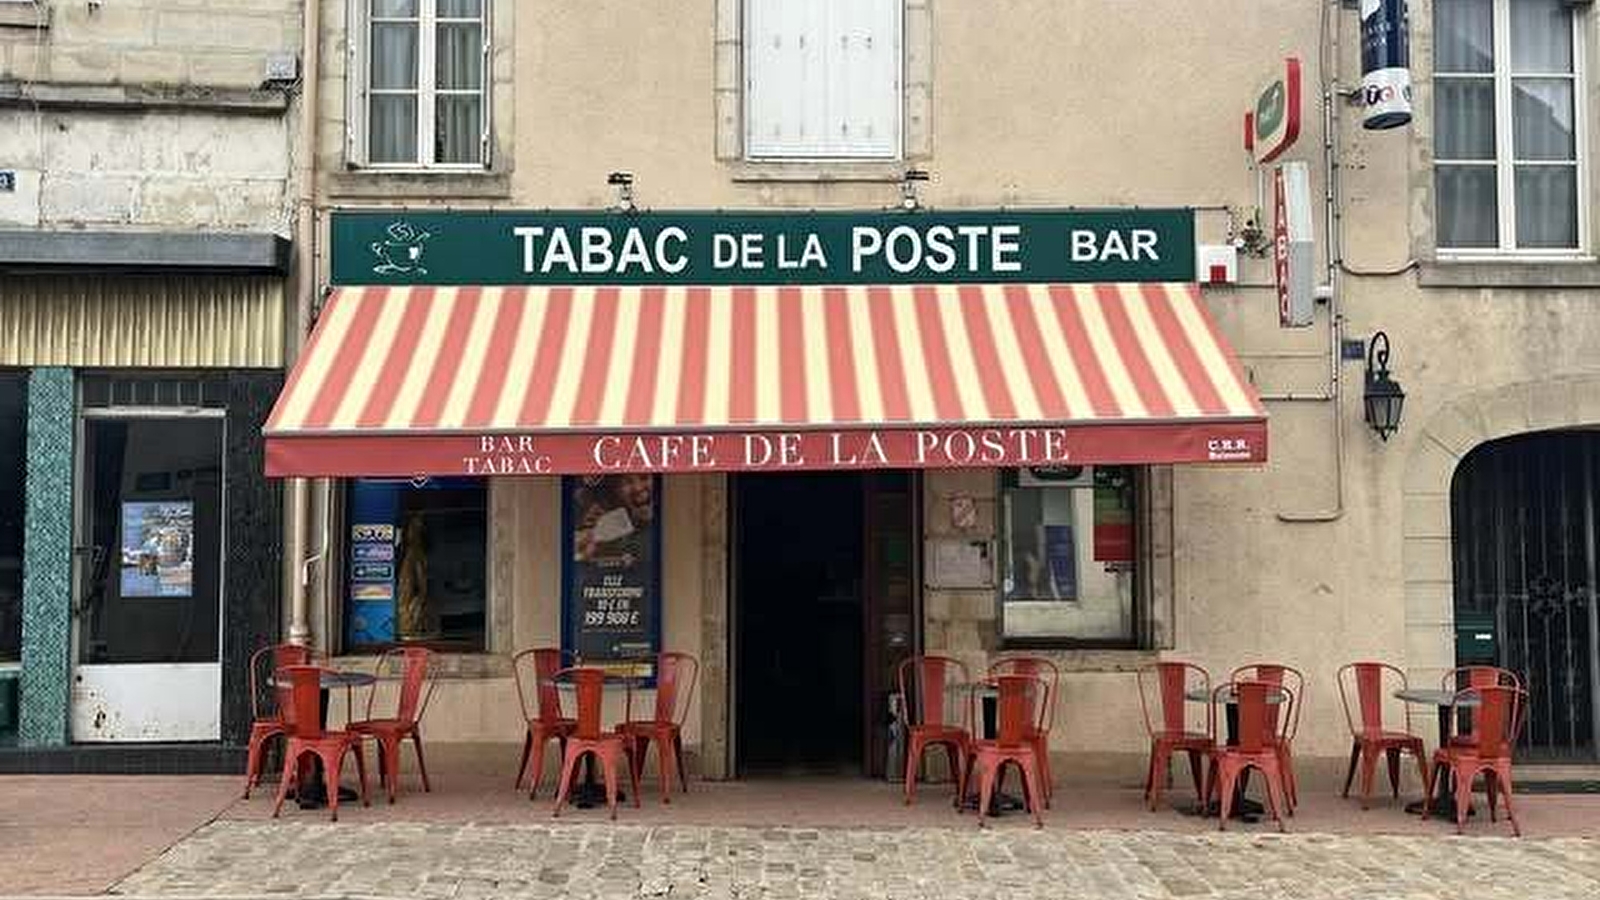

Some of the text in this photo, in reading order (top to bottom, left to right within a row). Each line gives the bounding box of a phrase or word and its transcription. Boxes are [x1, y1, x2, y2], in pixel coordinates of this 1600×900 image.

[513, 225, 1159, 274] TABAC DE LA POSTE BAR
[1274, 174, 1289, 317] TABAC
[480, 436, 535, 453] BAR
[593, 428, 1070, 469] CAFE DE LA POSTE
[463, 456, 552, 475] TABAC
